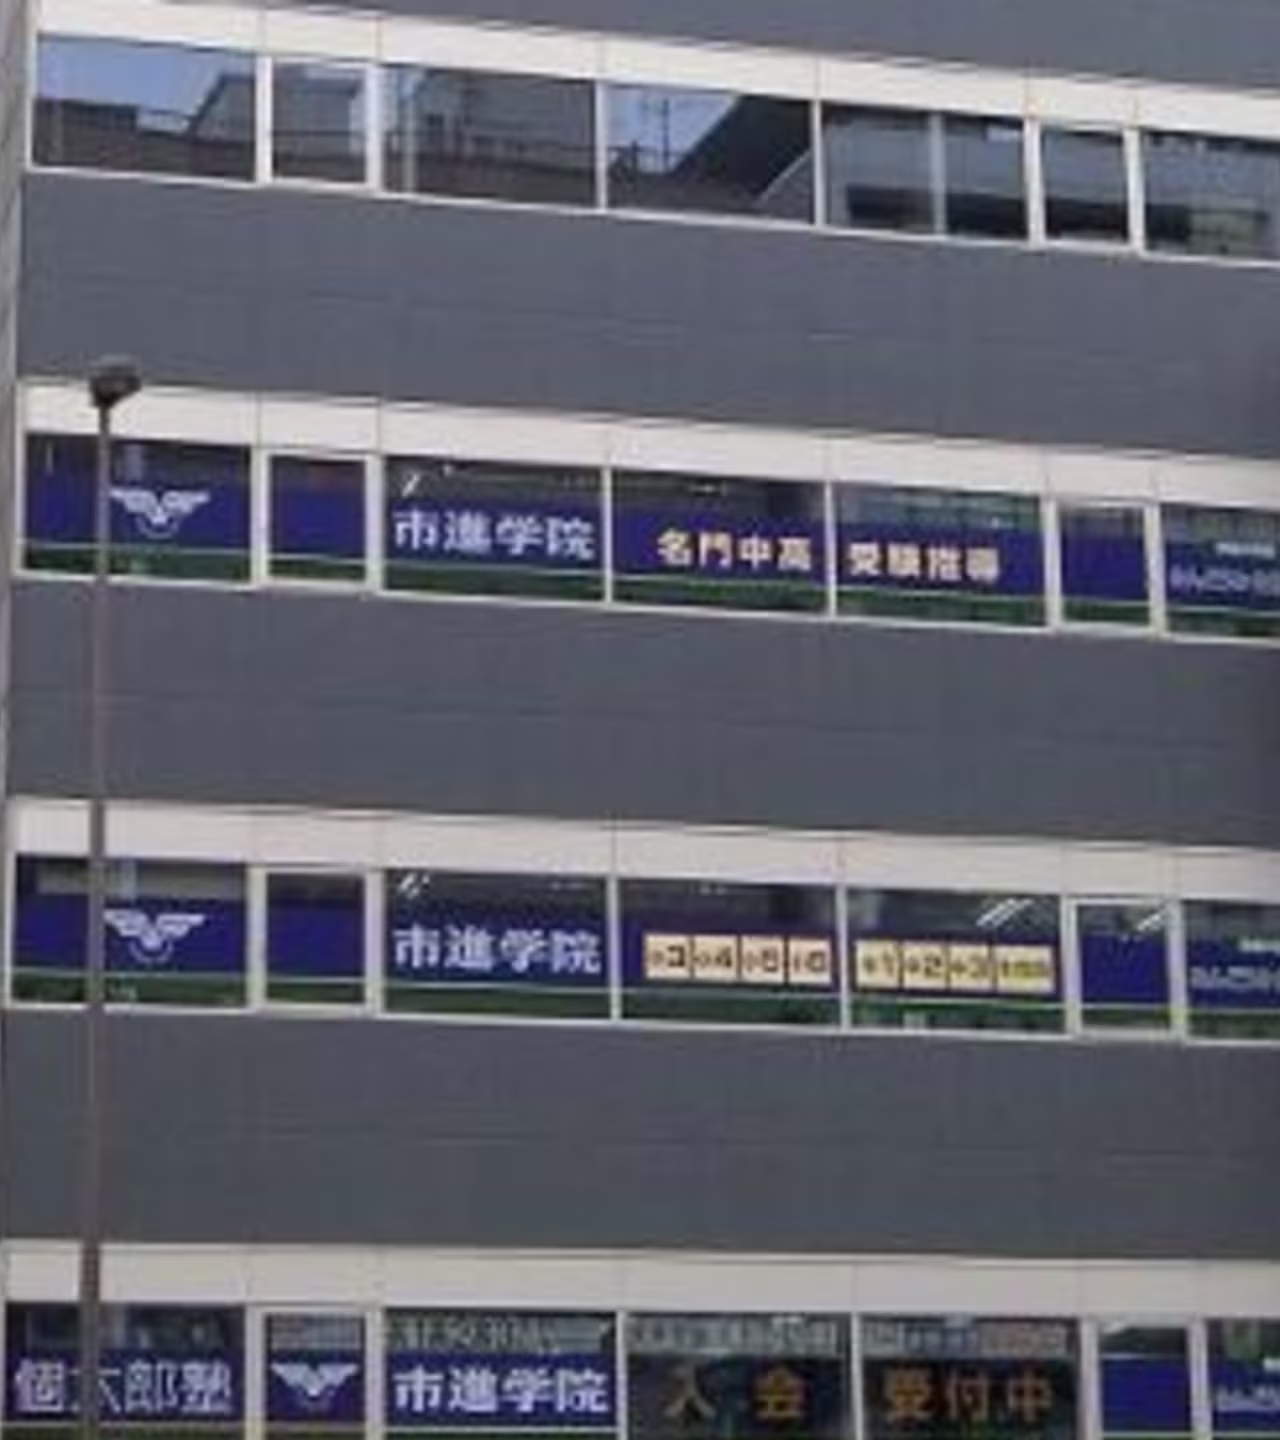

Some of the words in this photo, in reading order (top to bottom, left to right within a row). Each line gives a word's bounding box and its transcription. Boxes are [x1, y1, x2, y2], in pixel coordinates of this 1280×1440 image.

[391, 508, 596, 560] 市進学院
[656, 528, 812, 571] 名門中高
[391, 922, 602, 973] 市進学院
[392, 1364, 609, 1413] 市進学院
